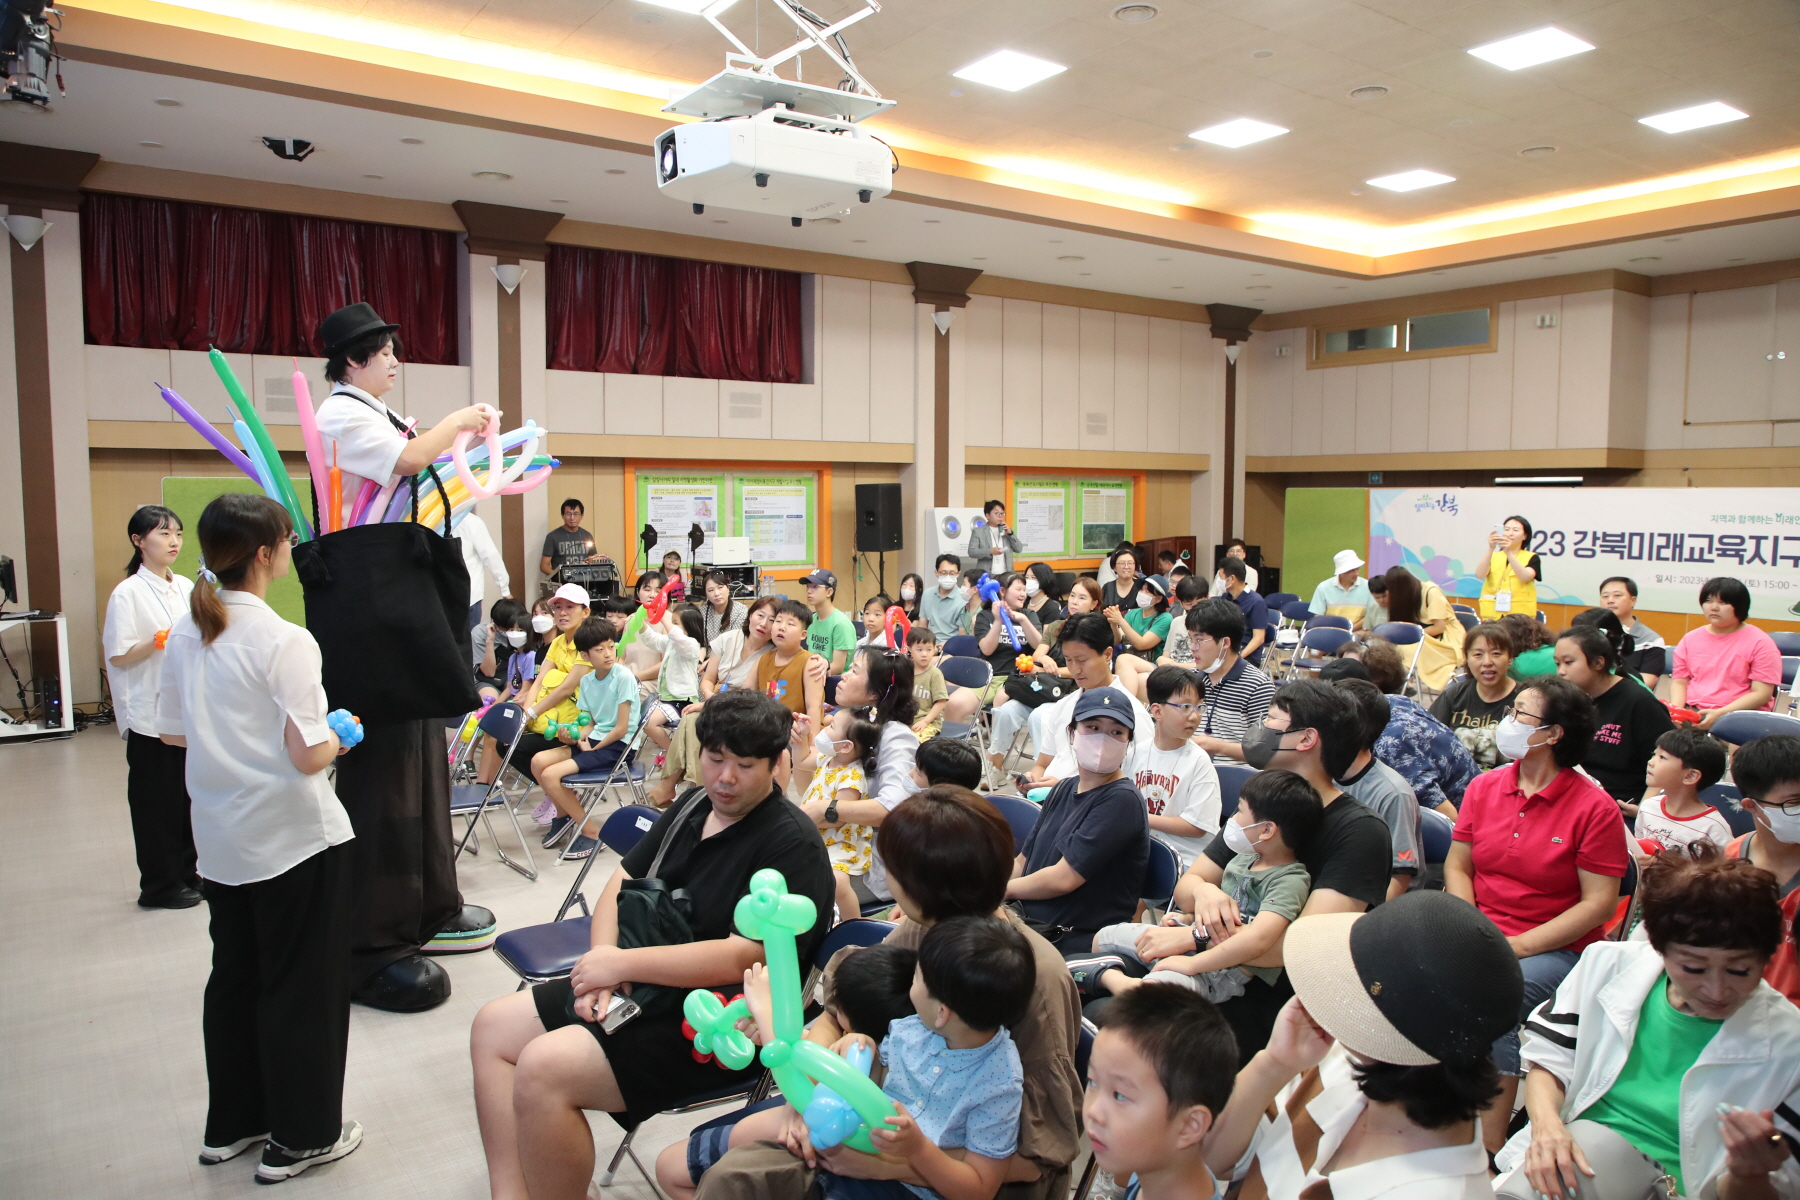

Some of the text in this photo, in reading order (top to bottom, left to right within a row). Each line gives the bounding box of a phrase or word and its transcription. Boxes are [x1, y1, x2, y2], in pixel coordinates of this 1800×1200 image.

[1435, 493, 1459, 516] 강북
[1711, 514, 1736, 523] 지역과
[1738, 514, 1774, 524] 함께하는
[1763, 580, 1790, 589] 15:00
[1451, 709, 1500, 730] Thaila
[1135, 770, 1180, 799] HARVARD
